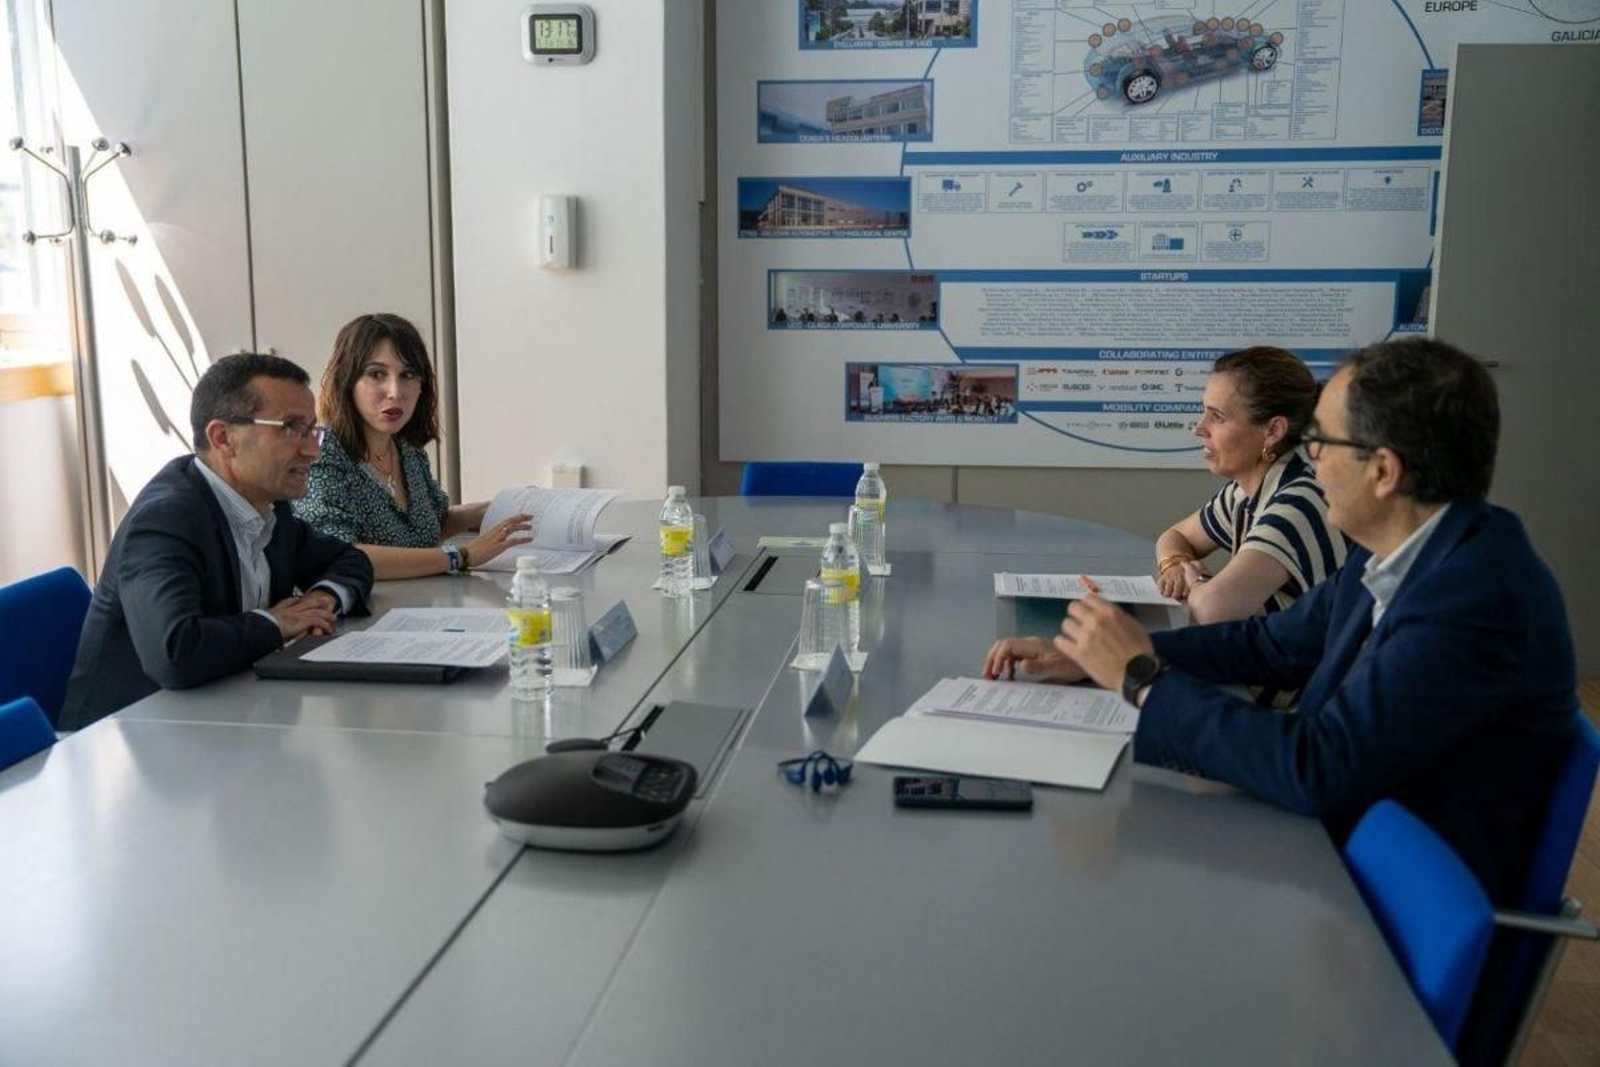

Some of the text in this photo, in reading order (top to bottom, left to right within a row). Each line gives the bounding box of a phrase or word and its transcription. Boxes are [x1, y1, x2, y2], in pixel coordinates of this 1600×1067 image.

[1424, 0, 1478, 12] EUROPE
[1120, 151, 1218, 162] AUXILIARY INDUSTRY
[1140, 272, 1189, 281] STARTUPS
[1099, 351, 1180, 360] COLLABORATING
[1102, 403, 1151, 412] MOBILITY
[902, 415, 934, 423] FACTORY
[964, 415, 998, 423] MOBILITY
